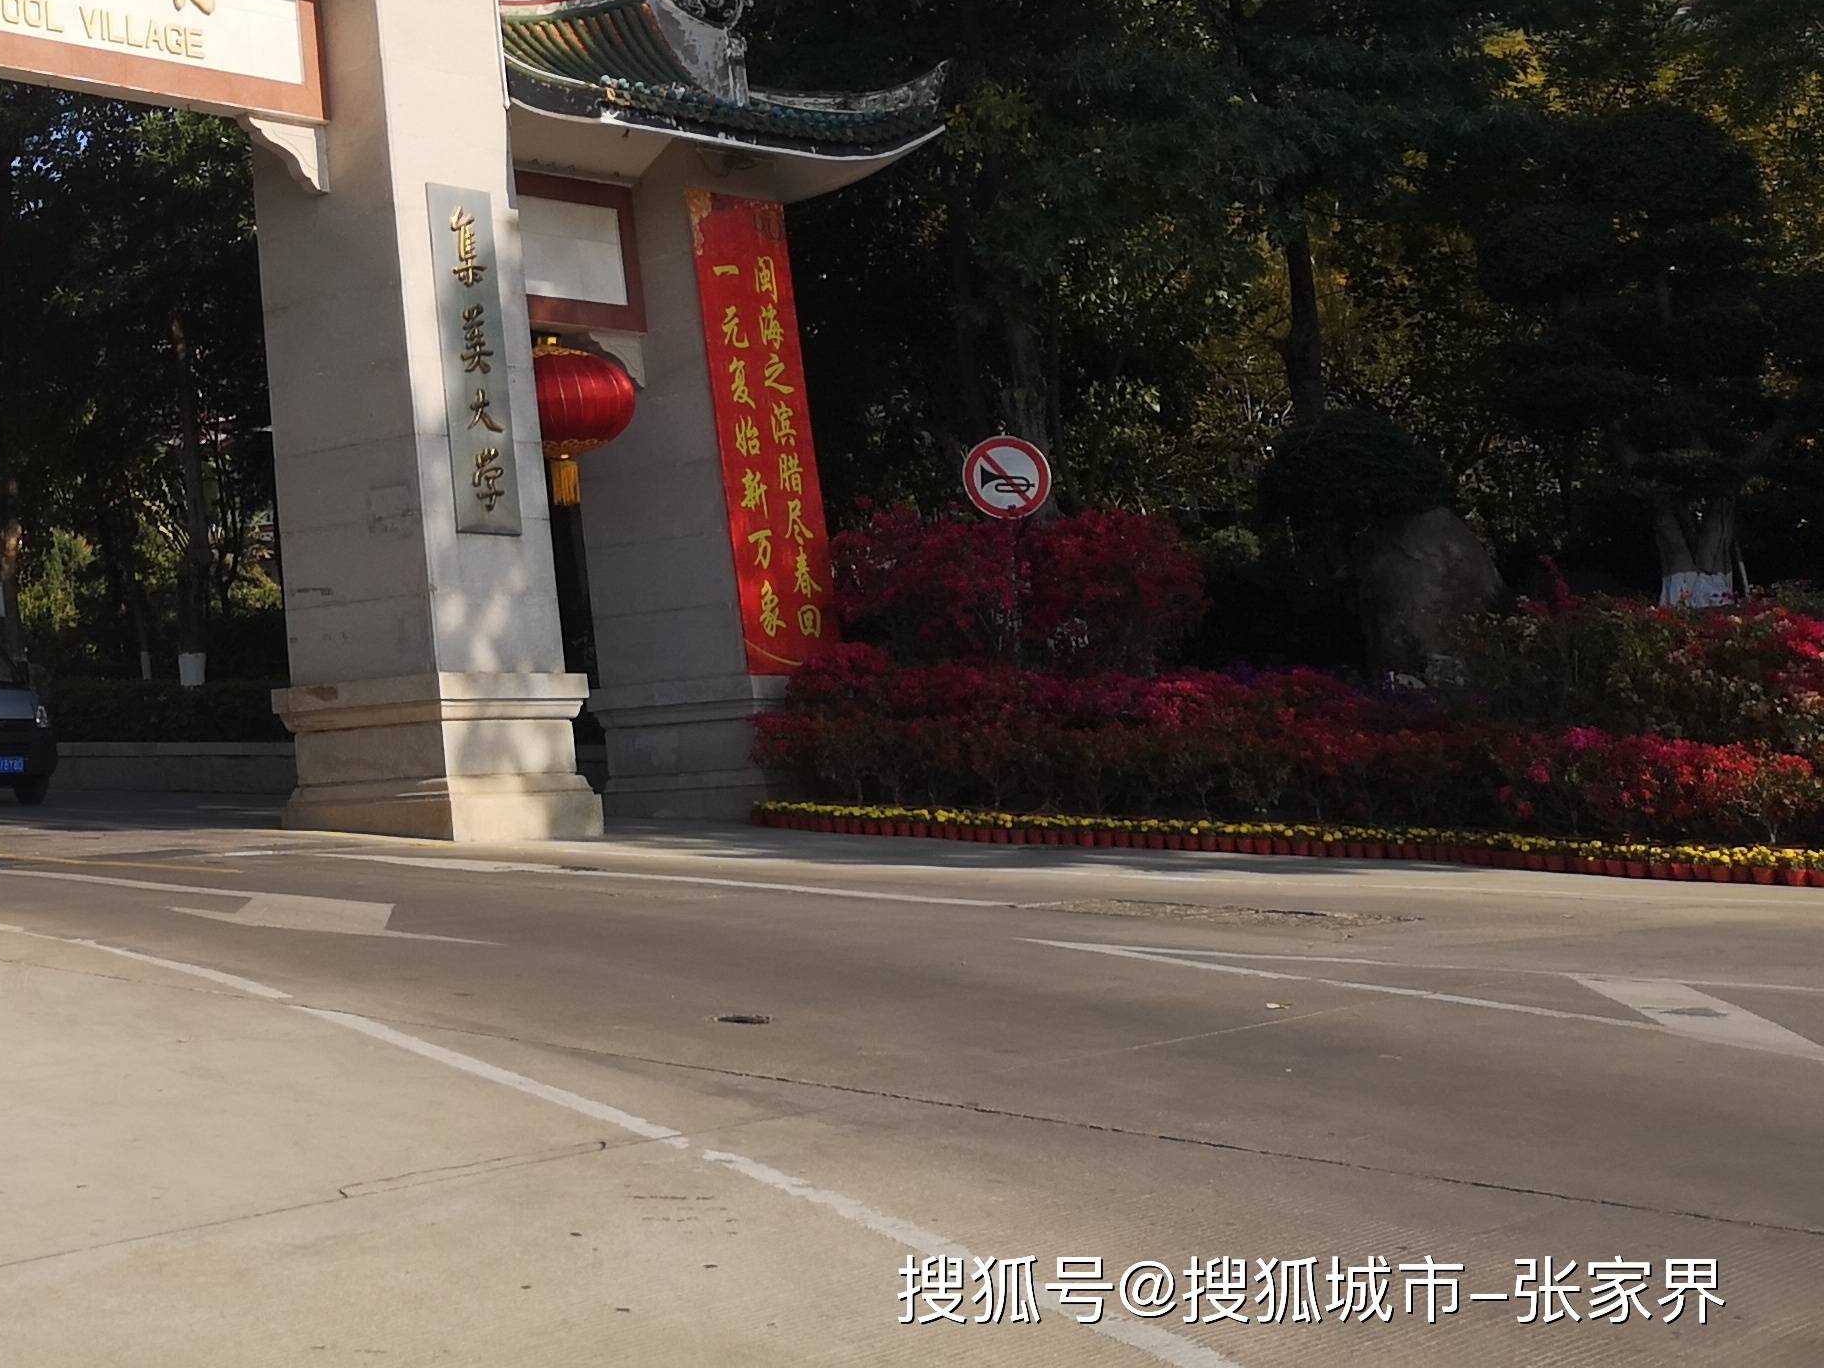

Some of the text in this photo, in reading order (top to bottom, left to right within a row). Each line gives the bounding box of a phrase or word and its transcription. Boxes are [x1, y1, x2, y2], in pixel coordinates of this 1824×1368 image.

[78, 5, 207, 60] VILLAGE
[449, 205, 505, 513] 集美大学
[712, 264, 787, 638] 一元复始新万象
[753, 256, 823, 640] 闽海之滨腊尽春回
